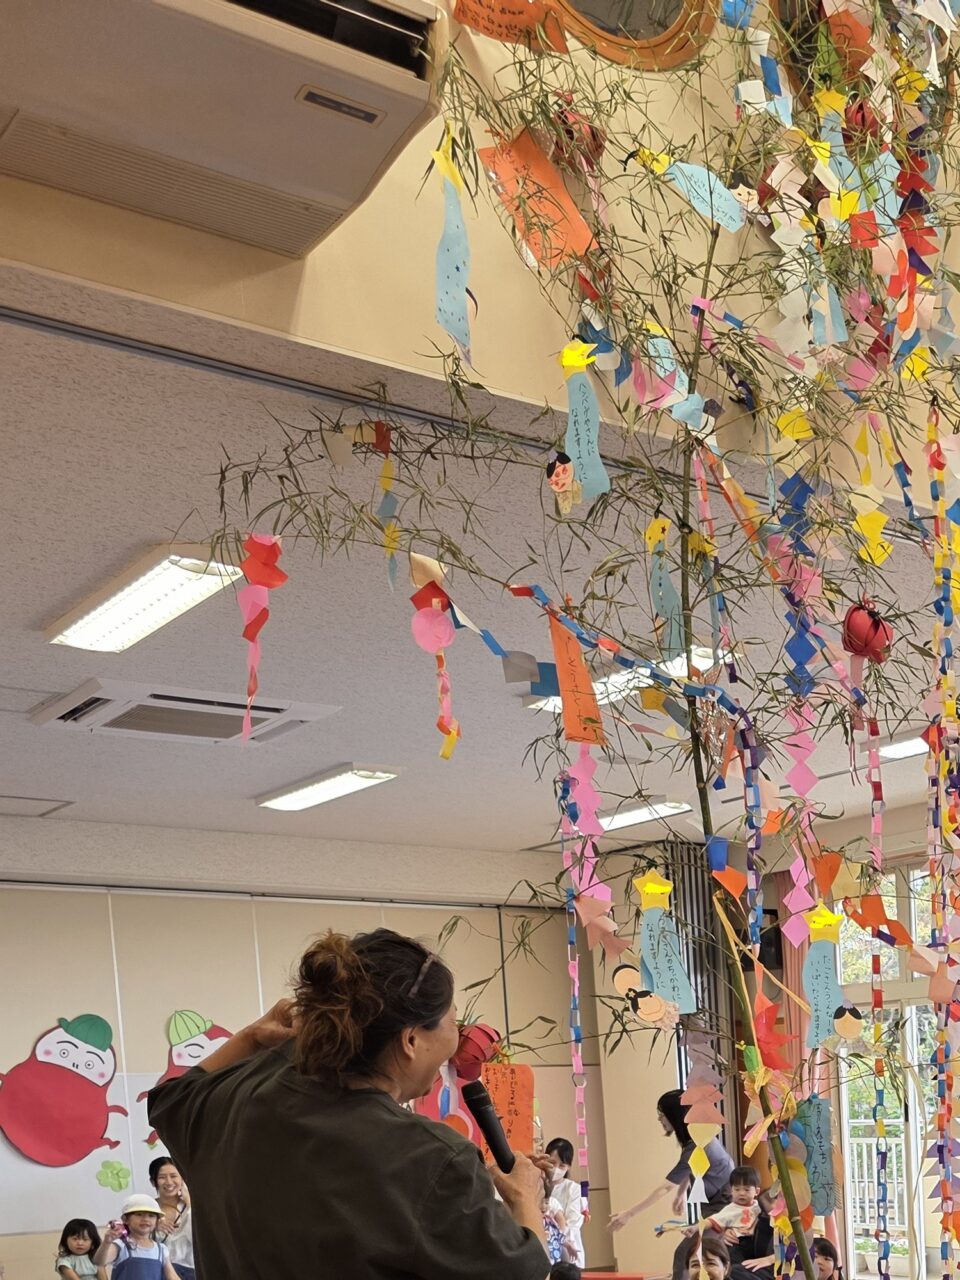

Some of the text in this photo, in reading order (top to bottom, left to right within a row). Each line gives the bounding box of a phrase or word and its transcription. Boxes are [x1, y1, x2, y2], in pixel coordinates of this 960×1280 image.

[571, 407, 588, 483] なれますように
[646, 923, 666, 990] なれますように
